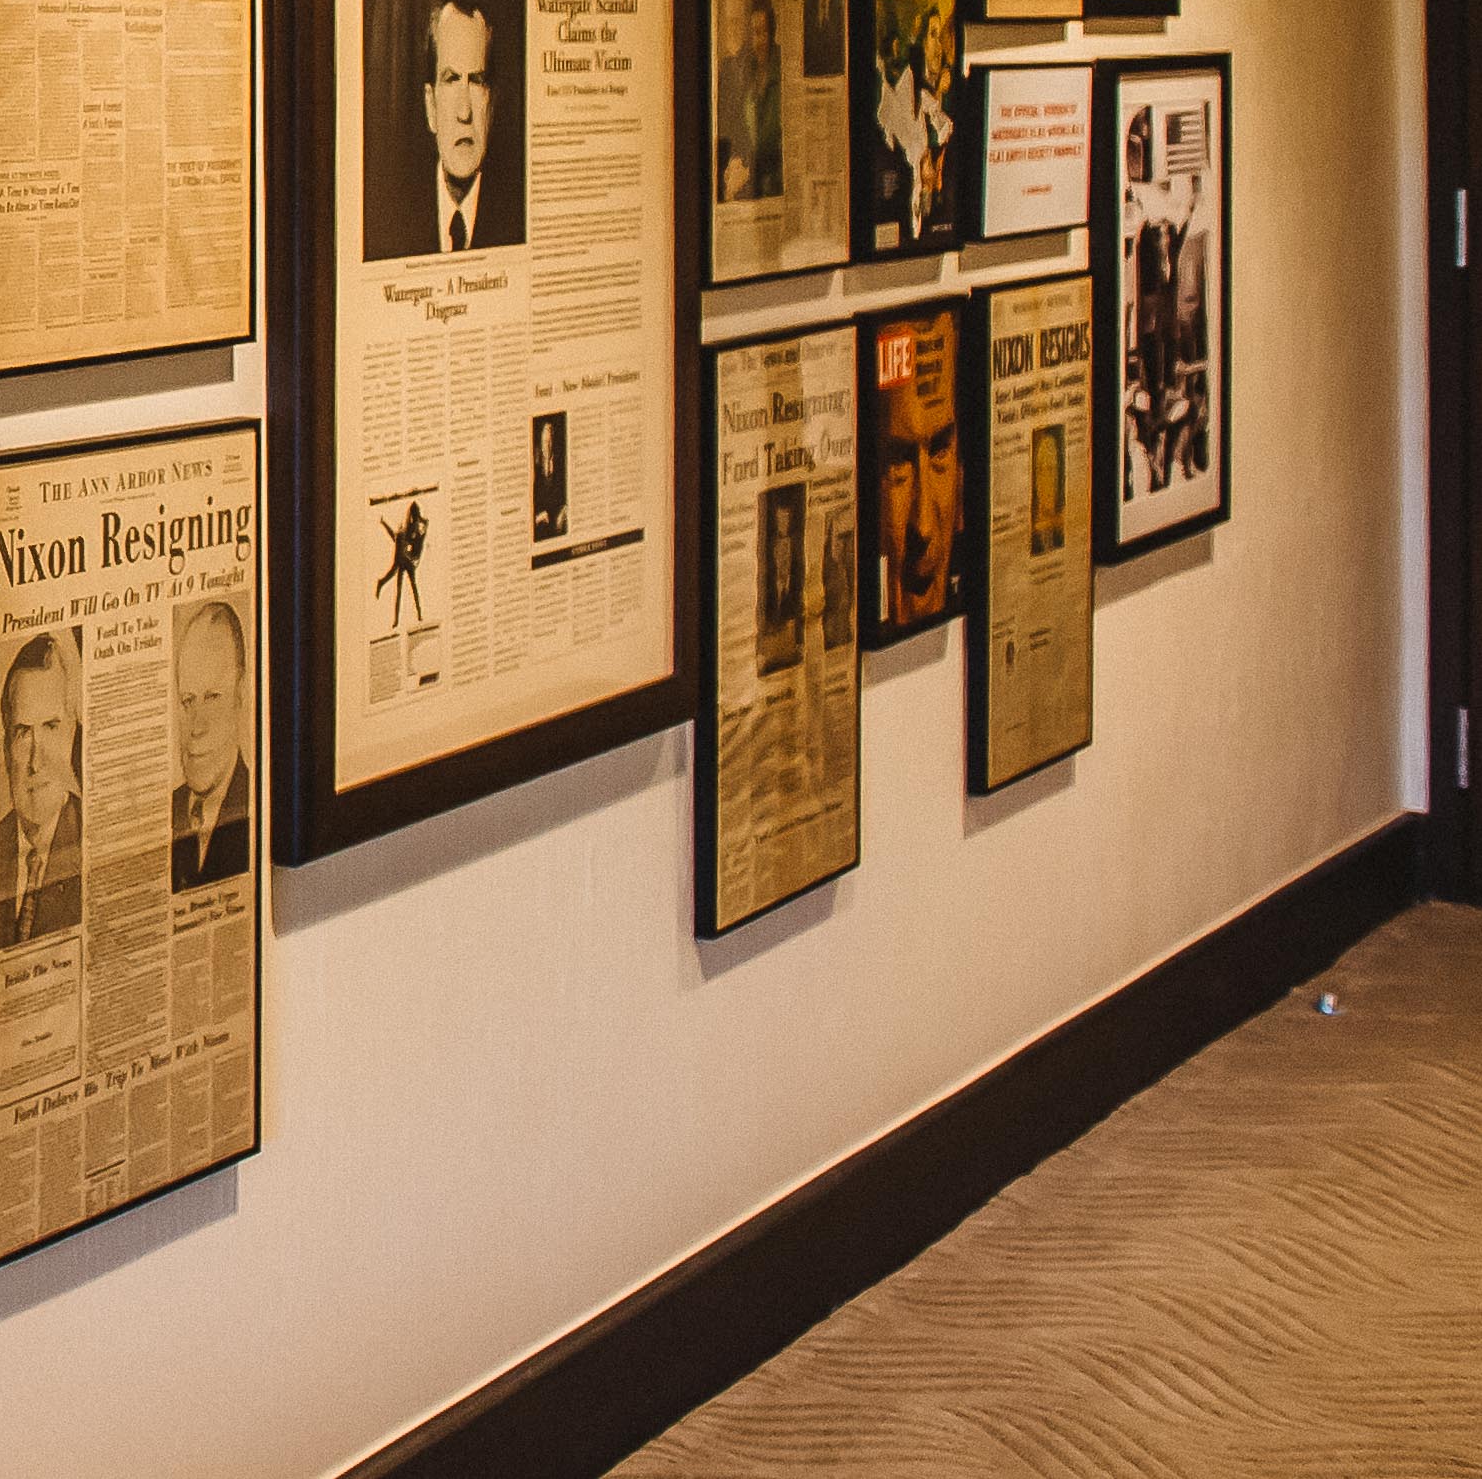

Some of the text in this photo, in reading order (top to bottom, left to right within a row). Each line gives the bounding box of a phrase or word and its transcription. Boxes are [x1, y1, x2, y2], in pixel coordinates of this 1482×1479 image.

[879, 336, 911, 384] LIFE
[993, 321, 1090, 380] NIXON RESIGNS
[39, 460, 213, 504] THE ANN ARBOR NEWS
[101, 496, 252, 574] Resigning
[3, 568, 245, 634] President Will Go On TV At 9 Tonight
